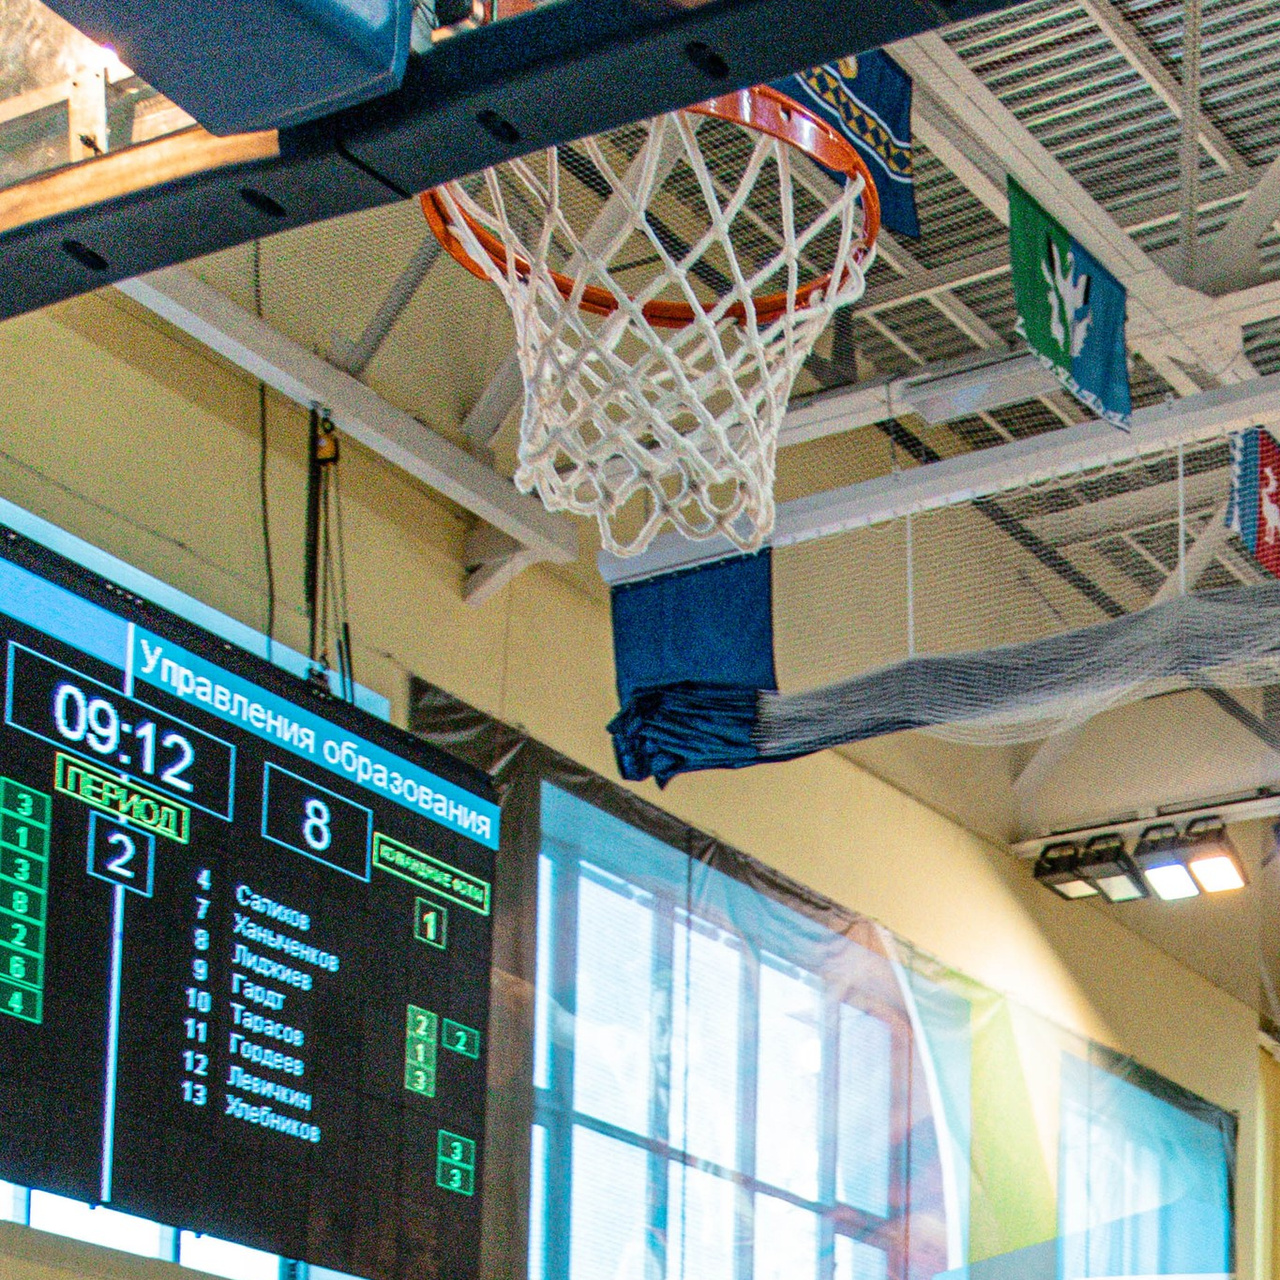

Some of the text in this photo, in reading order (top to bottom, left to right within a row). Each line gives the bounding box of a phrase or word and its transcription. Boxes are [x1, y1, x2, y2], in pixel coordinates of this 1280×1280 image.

[54, 684, 194, 792] 09:12
[140, 639, 491, 839] Управления образования
[17, 793, 33, 816] 3
[67, 765, 178, 836] ПЕРИОД
[16, 826, 28, 847] 1
[303, 799, 332, 851] 8
[107, 833, 136, 879] 2
[14, 858, 30, 881] 3
[197, 869, 211, 890] 4
[12, 890, 28, 913] 8
[195, 897, 211, 919] 7
[11, 923, 27, 946] 2
[423, 911, 437, 940] 1
[194, 929, 210, 950] 8
[192, 959, 287, 1010] 9 Гардт
[8, 991, 23, 1013] 4
[185, 987, 305, 1047] 10 Тарасов
[416, 1015, 428, 1035] 2
[184, 1018, 305, 1077] 11 Гордеев
[455, 1031, 468, 1050] 2
[416, 1043, 425, 1062] 1
[183, 1050, 312, 1111] 12 Левичкин
[414, 1070, 427, 1090] 3
[181, 1080, 321, 1143] 13 Хлебников
[450, 1141, 463, 1160] 3
[449, 1168, 462, 1188] 3
